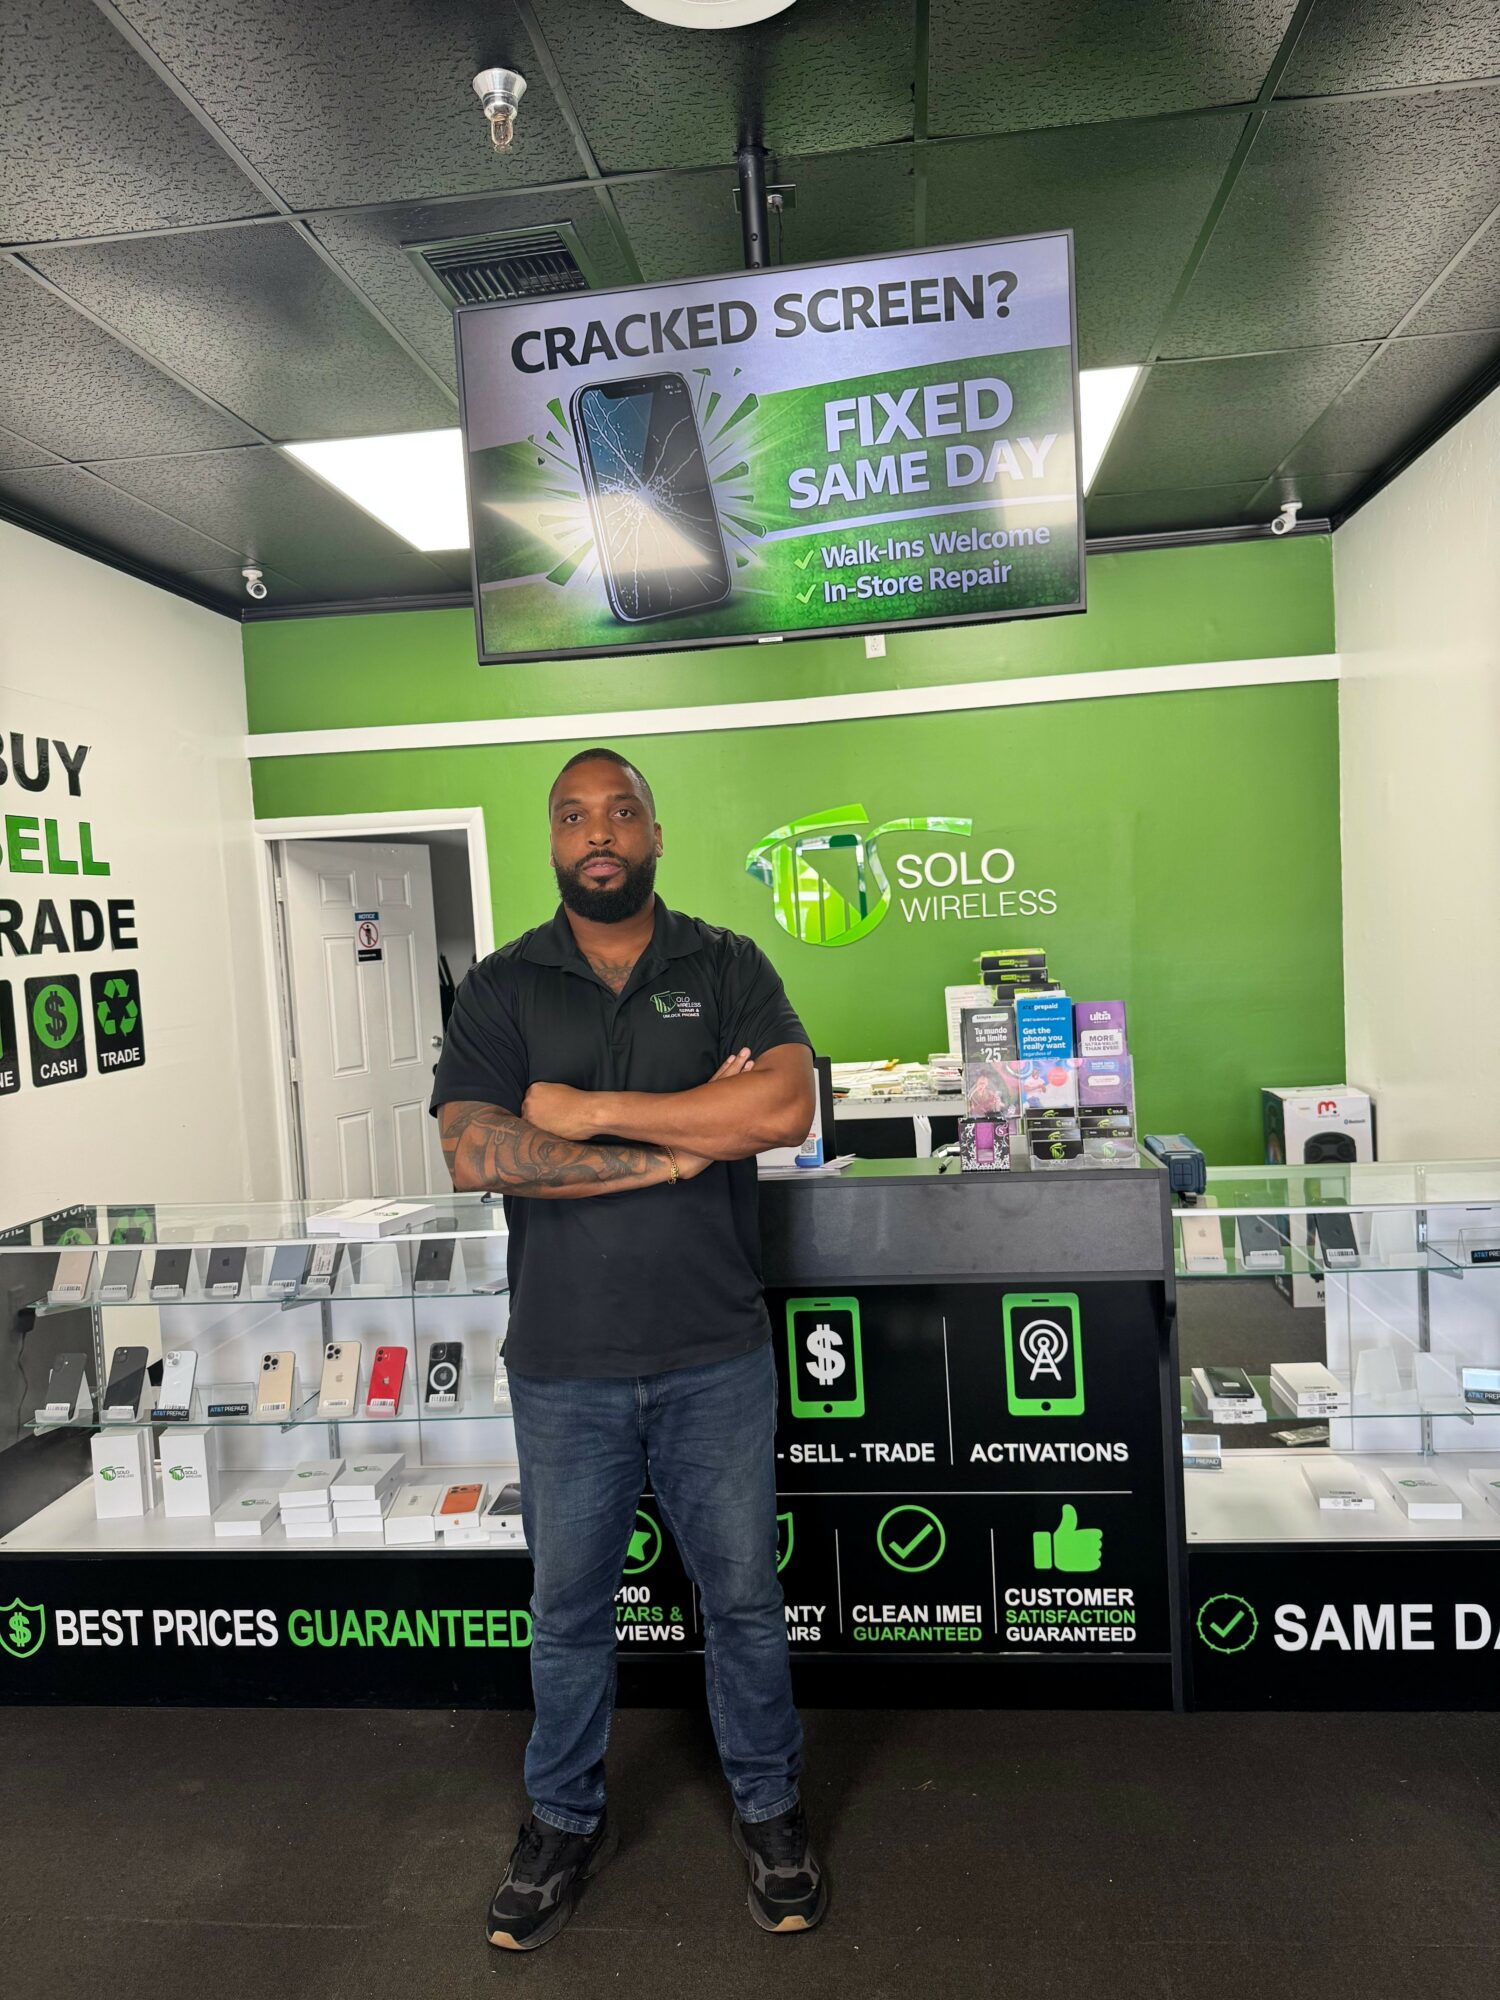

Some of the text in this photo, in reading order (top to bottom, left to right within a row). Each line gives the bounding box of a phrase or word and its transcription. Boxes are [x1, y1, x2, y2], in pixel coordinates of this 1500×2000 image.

[511, 271, 1018, 374] CRACKED SCREEN?
[824, 377, 1014, 453] FIXED
[788, 433, 1058, 509] SAME DAY
[821, 526, 1051, 569] Walk-Ins Welcome
[823, 560, 1012, 603] In-Store Repair
[0, 814, 111, 876] ELL
[896, 848, 1015, 889] SOLO
[900, 889, 1058, 923] WIRELESS
[0, 899, 139, 957] RADE
[1034, 1002, 1059, 1011] prepaid
[974, 1026, 1007, 1035] Tu mundo
[1023, 1035, 1063, 1044] phone you
[1023, 1043, 1045, 1051] really
[101, 1047, 140, 1067] TRADE
[40, 1058, 78, 1079] CASH
[790, 1444, 843, 1462] SELL
[861, 1443, 935, 1462] TRADE
[970, 1443, 1129, 1462] ACTIVATIONS
[1005, 1588, 1134, 1606] CUSTOMER
[616, 1606, 683, 1622] TARS &
[853, 1605, 982, 1623] CLEAN IMEI
[1006, 1609, 1136, 1624] SATISFACTION
[56, 1609, 533, 1648] BEST PRICES GUARANTEED
[616, 1625, 685, 1641] VIEWS
[854, 1626, 982, 1641] GUARANTEED
[1006, 1627, 1136, 1642] GUARANTEED
[1274, 1603, 1500, 1651] SAME D
